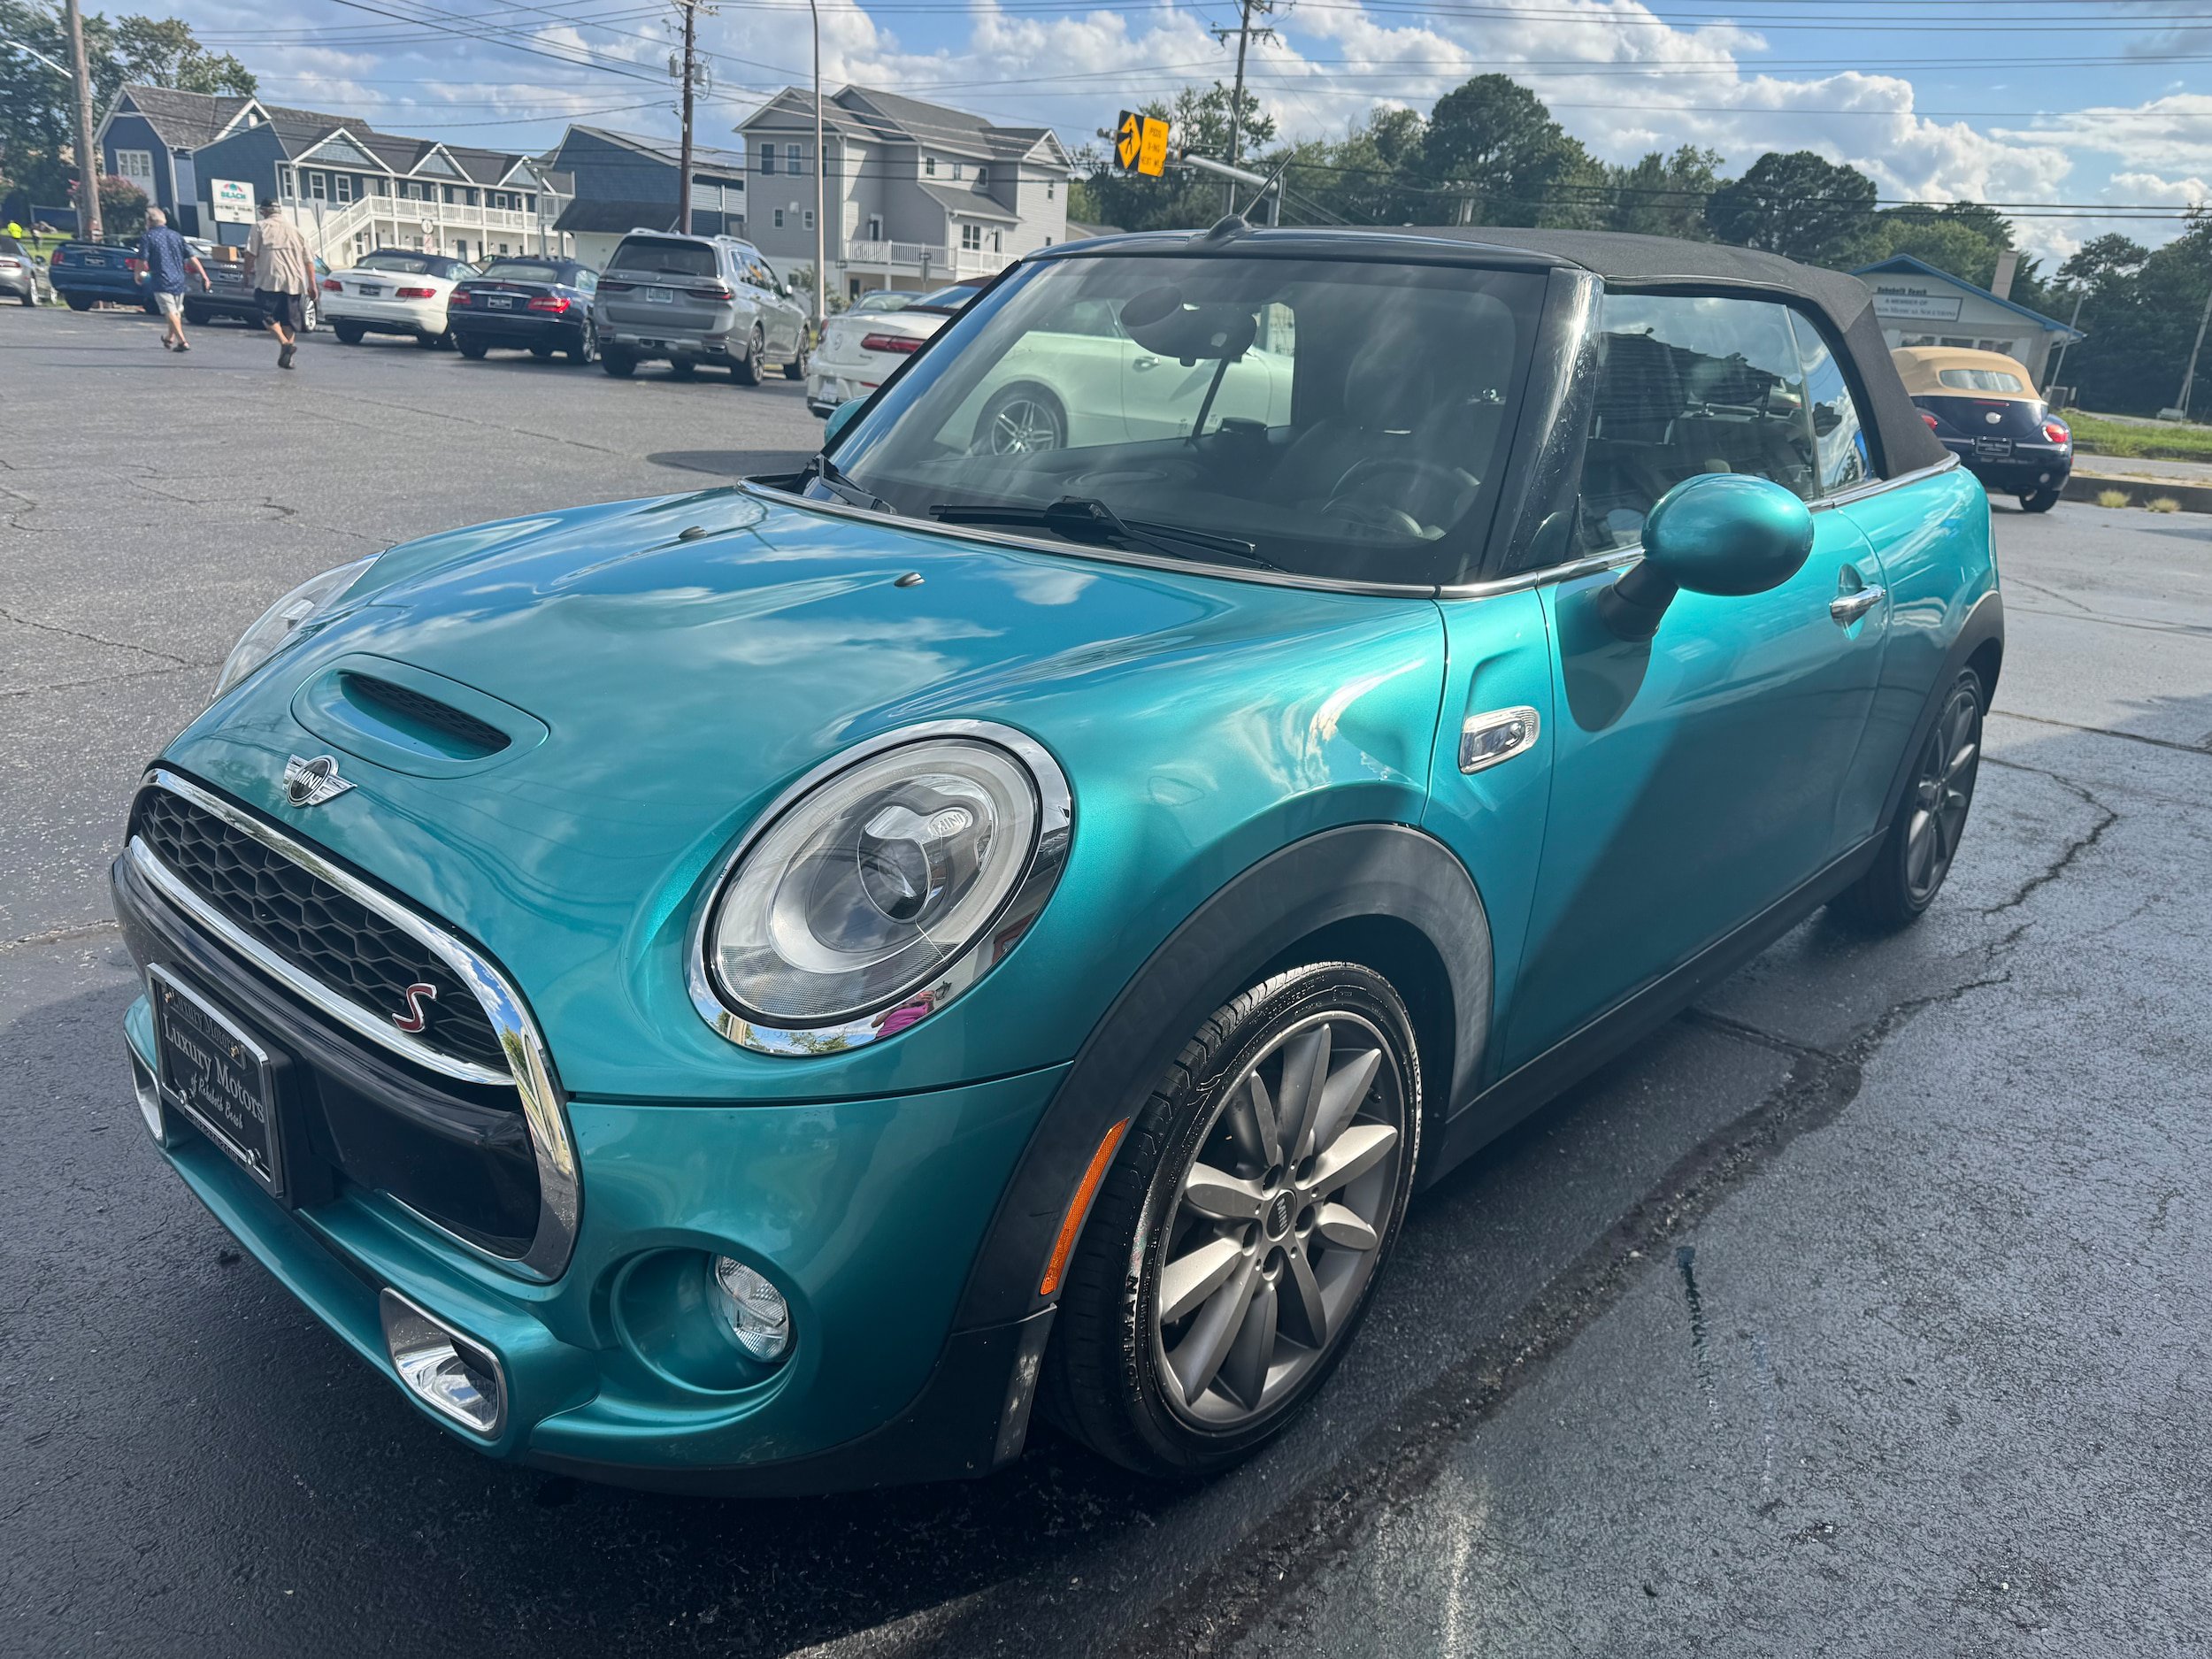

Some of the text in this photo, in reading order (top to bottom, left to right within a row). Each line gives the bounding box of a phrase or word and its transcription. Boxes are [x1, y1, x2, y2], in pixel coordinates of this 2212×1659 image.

[295, 769, 323, 790] MINI
[933, 813, 964, 835] MINI
[392, 983, 437, 1033] S
[162, 1012, 265, 1124] Luxury Motors
[1276, 1197, 1288, 1232] MINI
